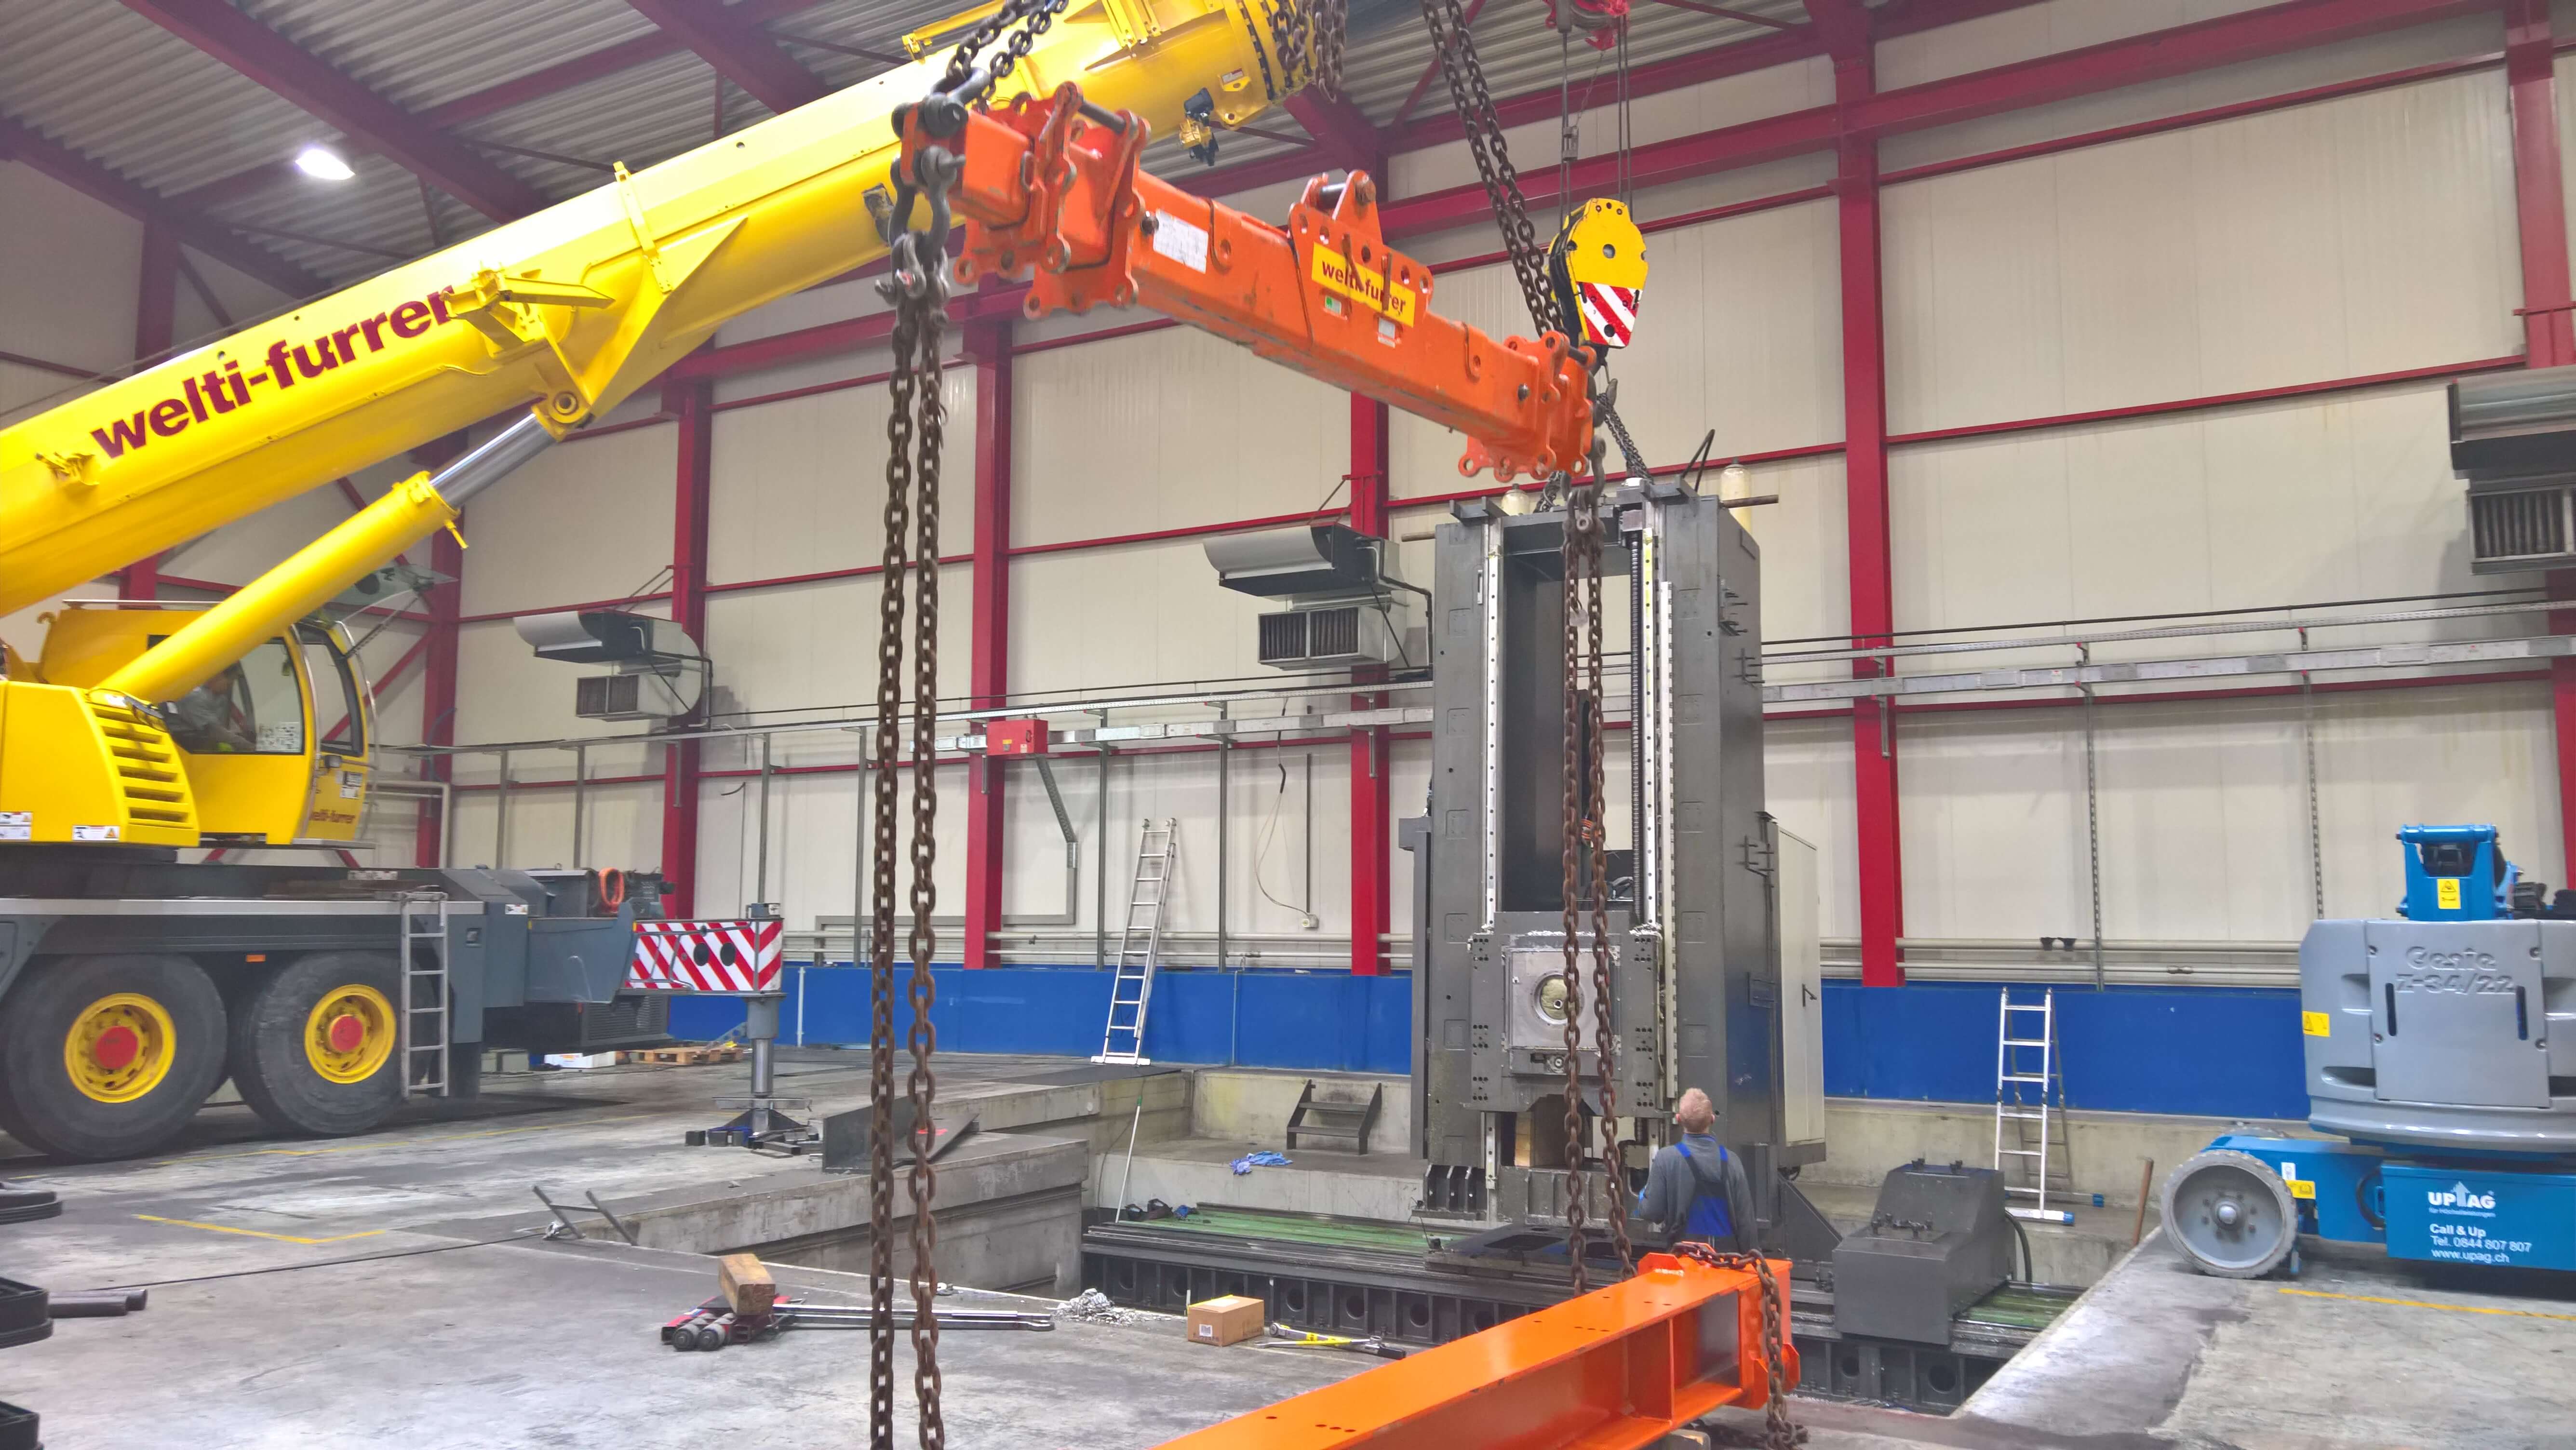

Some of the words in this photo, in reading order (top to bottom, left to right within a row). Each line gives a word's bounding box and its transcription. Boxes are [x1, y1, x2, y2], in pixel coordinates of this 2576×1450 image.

[2406, 946, 2497, 970] Genie
[2396, 973, 2516, 995] Z-34/22
[2429, 1223, 2454, 1235] Call
[2456, 1225, 2467, 1236] &
[2468, 1226, 2486, 1238] Up
[2430, 1235, 2453, 1247] Tel.
[2453, 1237, 2482, 1249] 0844
[2484, 1239, 2507, 1250] 807
[2509, 1241, 2532, 1252] 807
[2431, 1249, 2510, 1263] www.upag.ch
